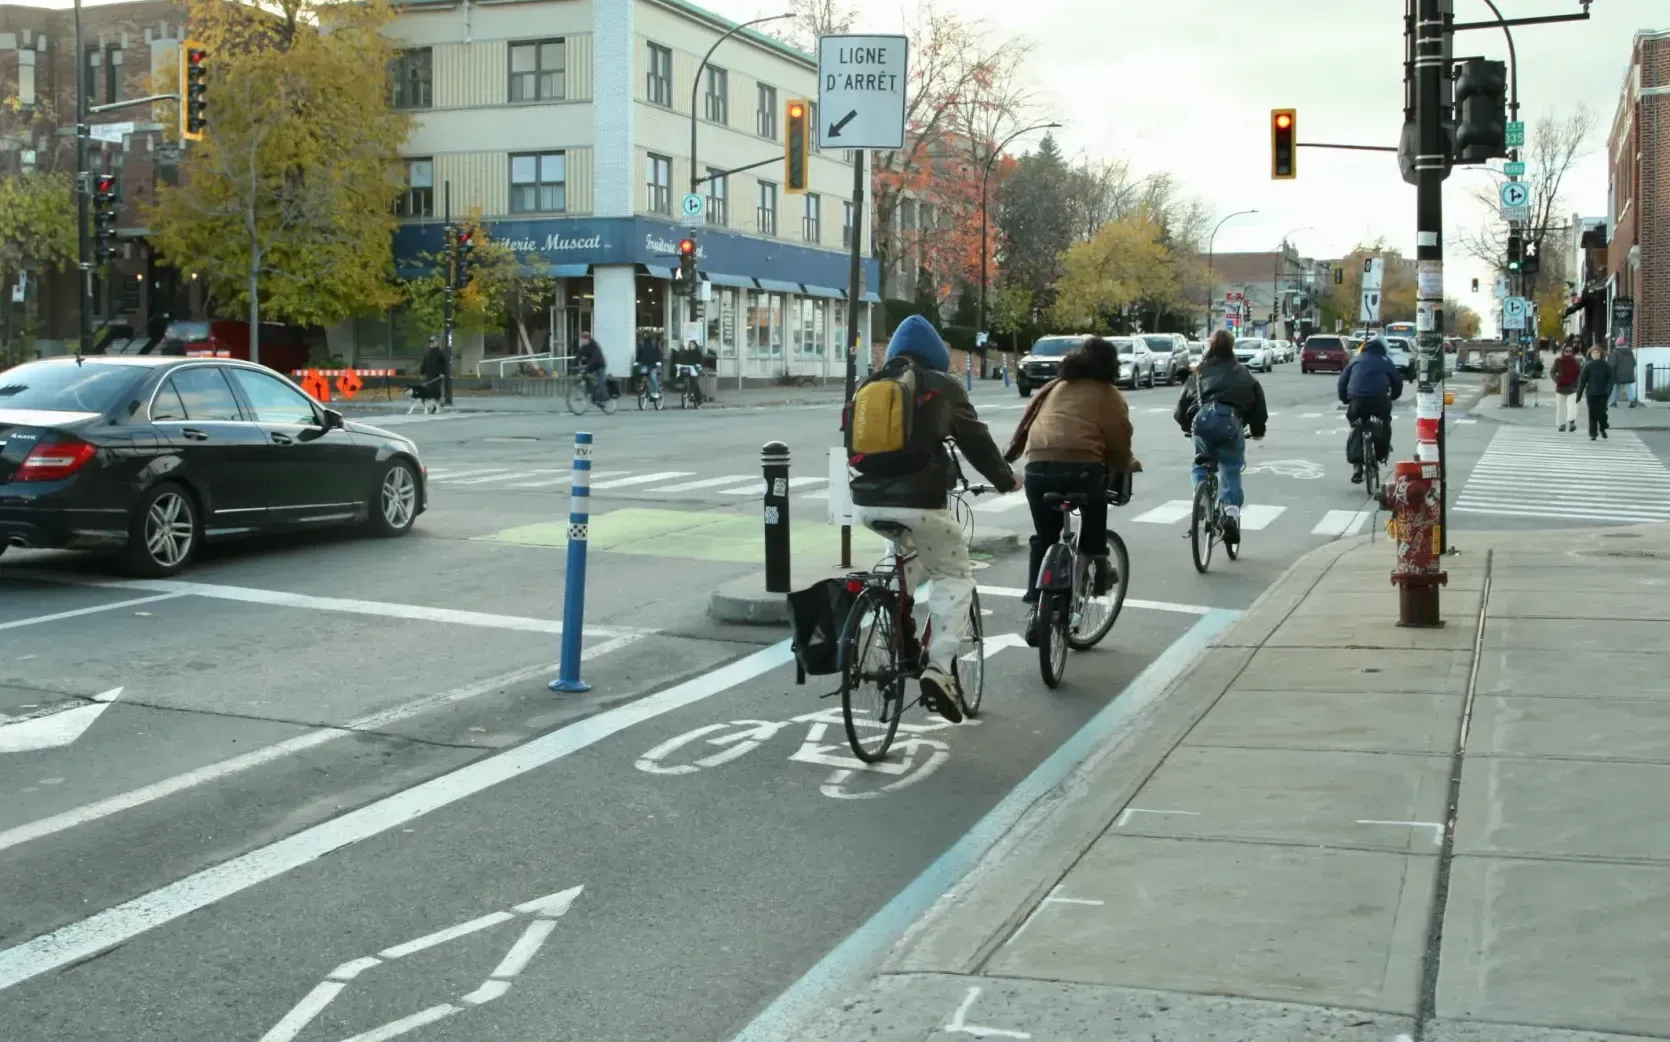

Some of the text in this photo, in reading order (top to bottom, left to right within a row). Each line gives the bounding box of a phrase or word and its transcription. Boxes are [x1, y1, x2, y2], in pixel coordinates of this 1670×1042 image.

[840, 47, 886, 64] LIGNE
[826, 70, 897, 91] D'ARRÊT
[1505, 133, 1523, 144] 335
[540, 233, 601, 252] Muscat
